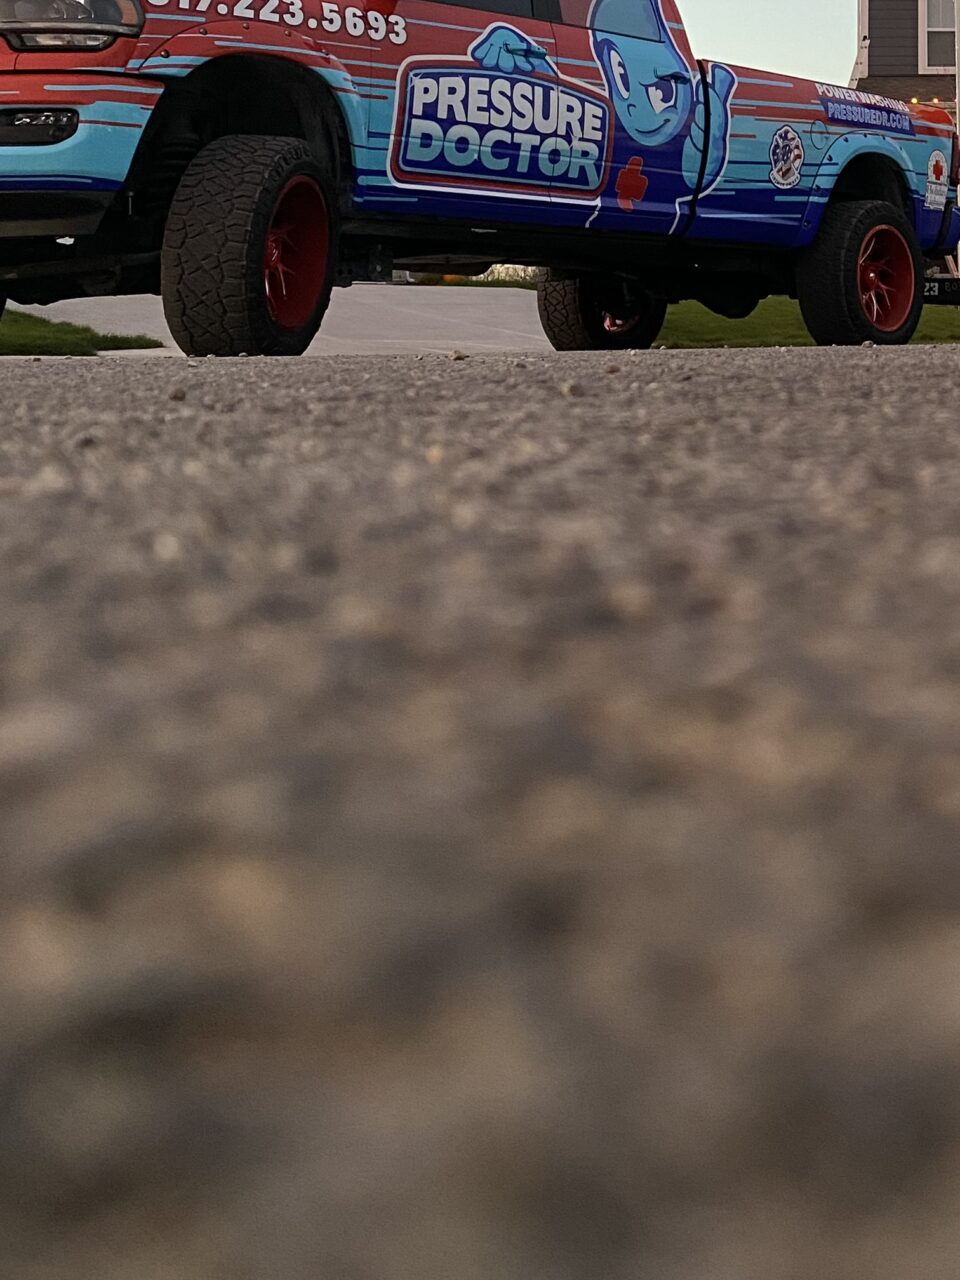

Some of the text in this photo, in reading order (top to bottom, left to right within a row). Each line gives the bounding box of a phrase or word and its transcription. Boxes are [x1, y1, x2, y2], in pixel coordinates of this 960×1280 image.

[412, 75, 603, 141] PRESSURE
[814, 82, 910, 112] POWER WASHING
[827, 101, 910, 130] PRESSUREDR.COM
[405, 119, 601, 187] DOCTOR
